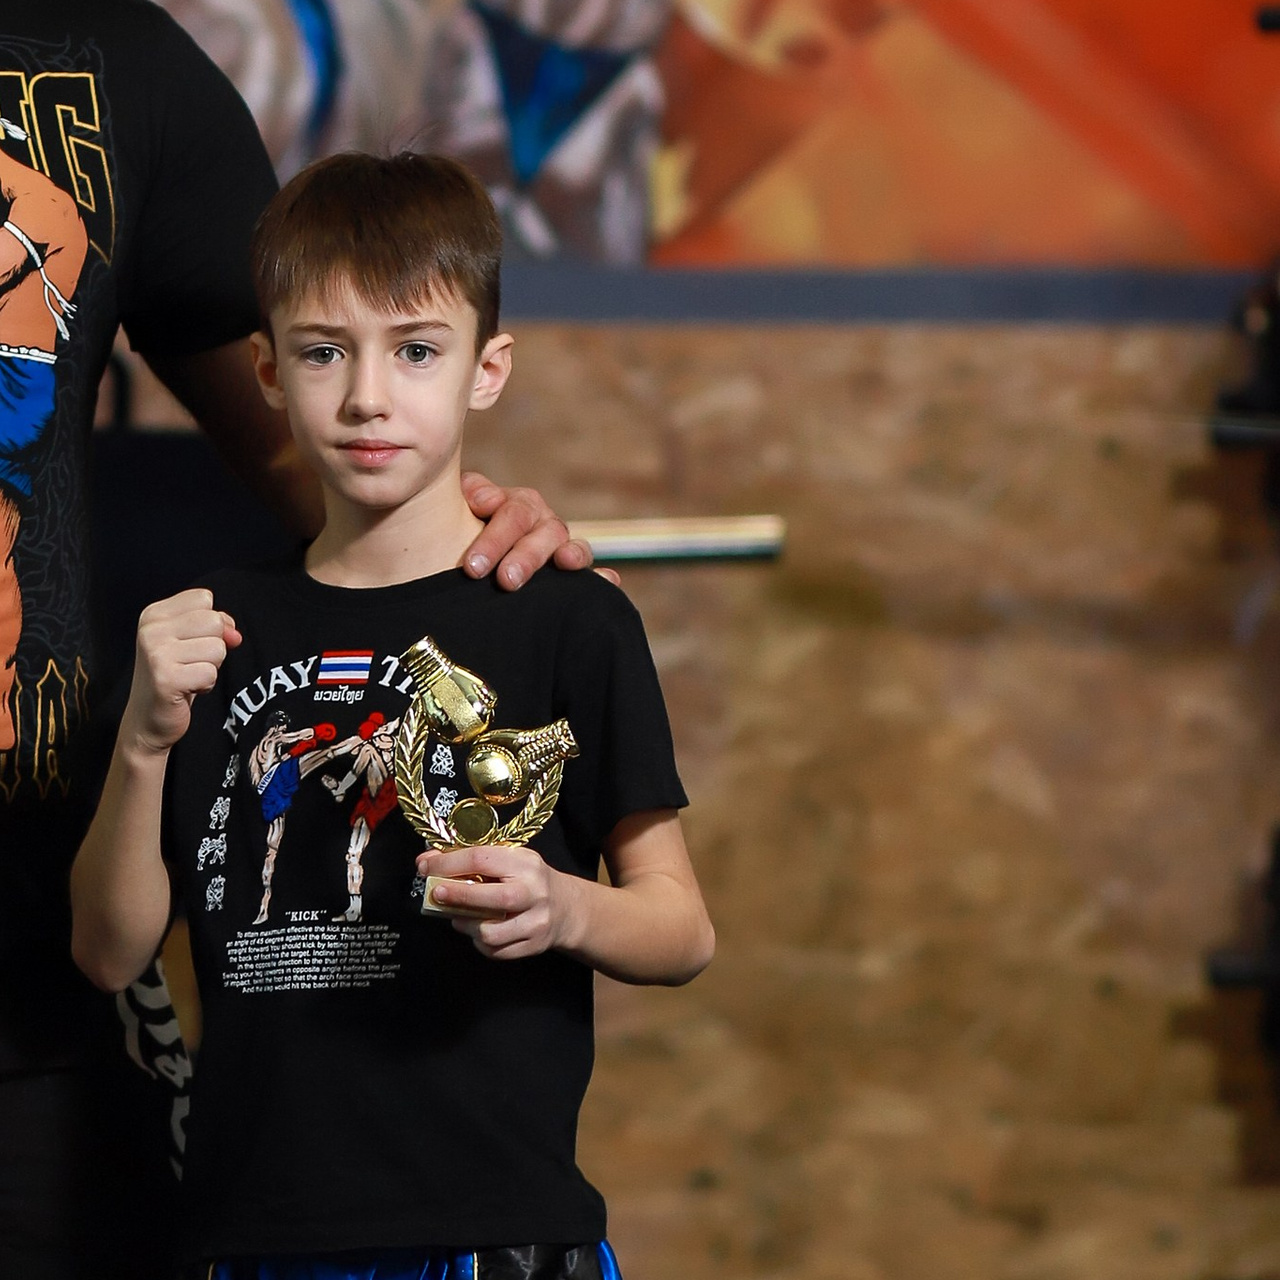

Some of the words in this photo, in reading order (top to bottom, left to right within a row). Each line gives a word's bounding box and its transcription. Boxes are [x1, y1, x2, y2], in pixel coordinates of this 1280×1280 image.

[223, 655, 319, 744] MUAY
[287, 926, 312, 934] effective
[234, 940, 249, 948] angle
[264, 936, 284, 944] degree
[285, 934, 308, 942] against
[282, 942, 302, 950] should
[327, 940, 348, 949] letting
[238, 954, 252, 962] back
[244, 962, 254, 970] the
[292, 966, 320, 974] opposite
[322, 966, 341, 974] angle
[343, 964, 366, 972] before
[336, 972, 351, 980] face
[242, 986, 255, 994] And
